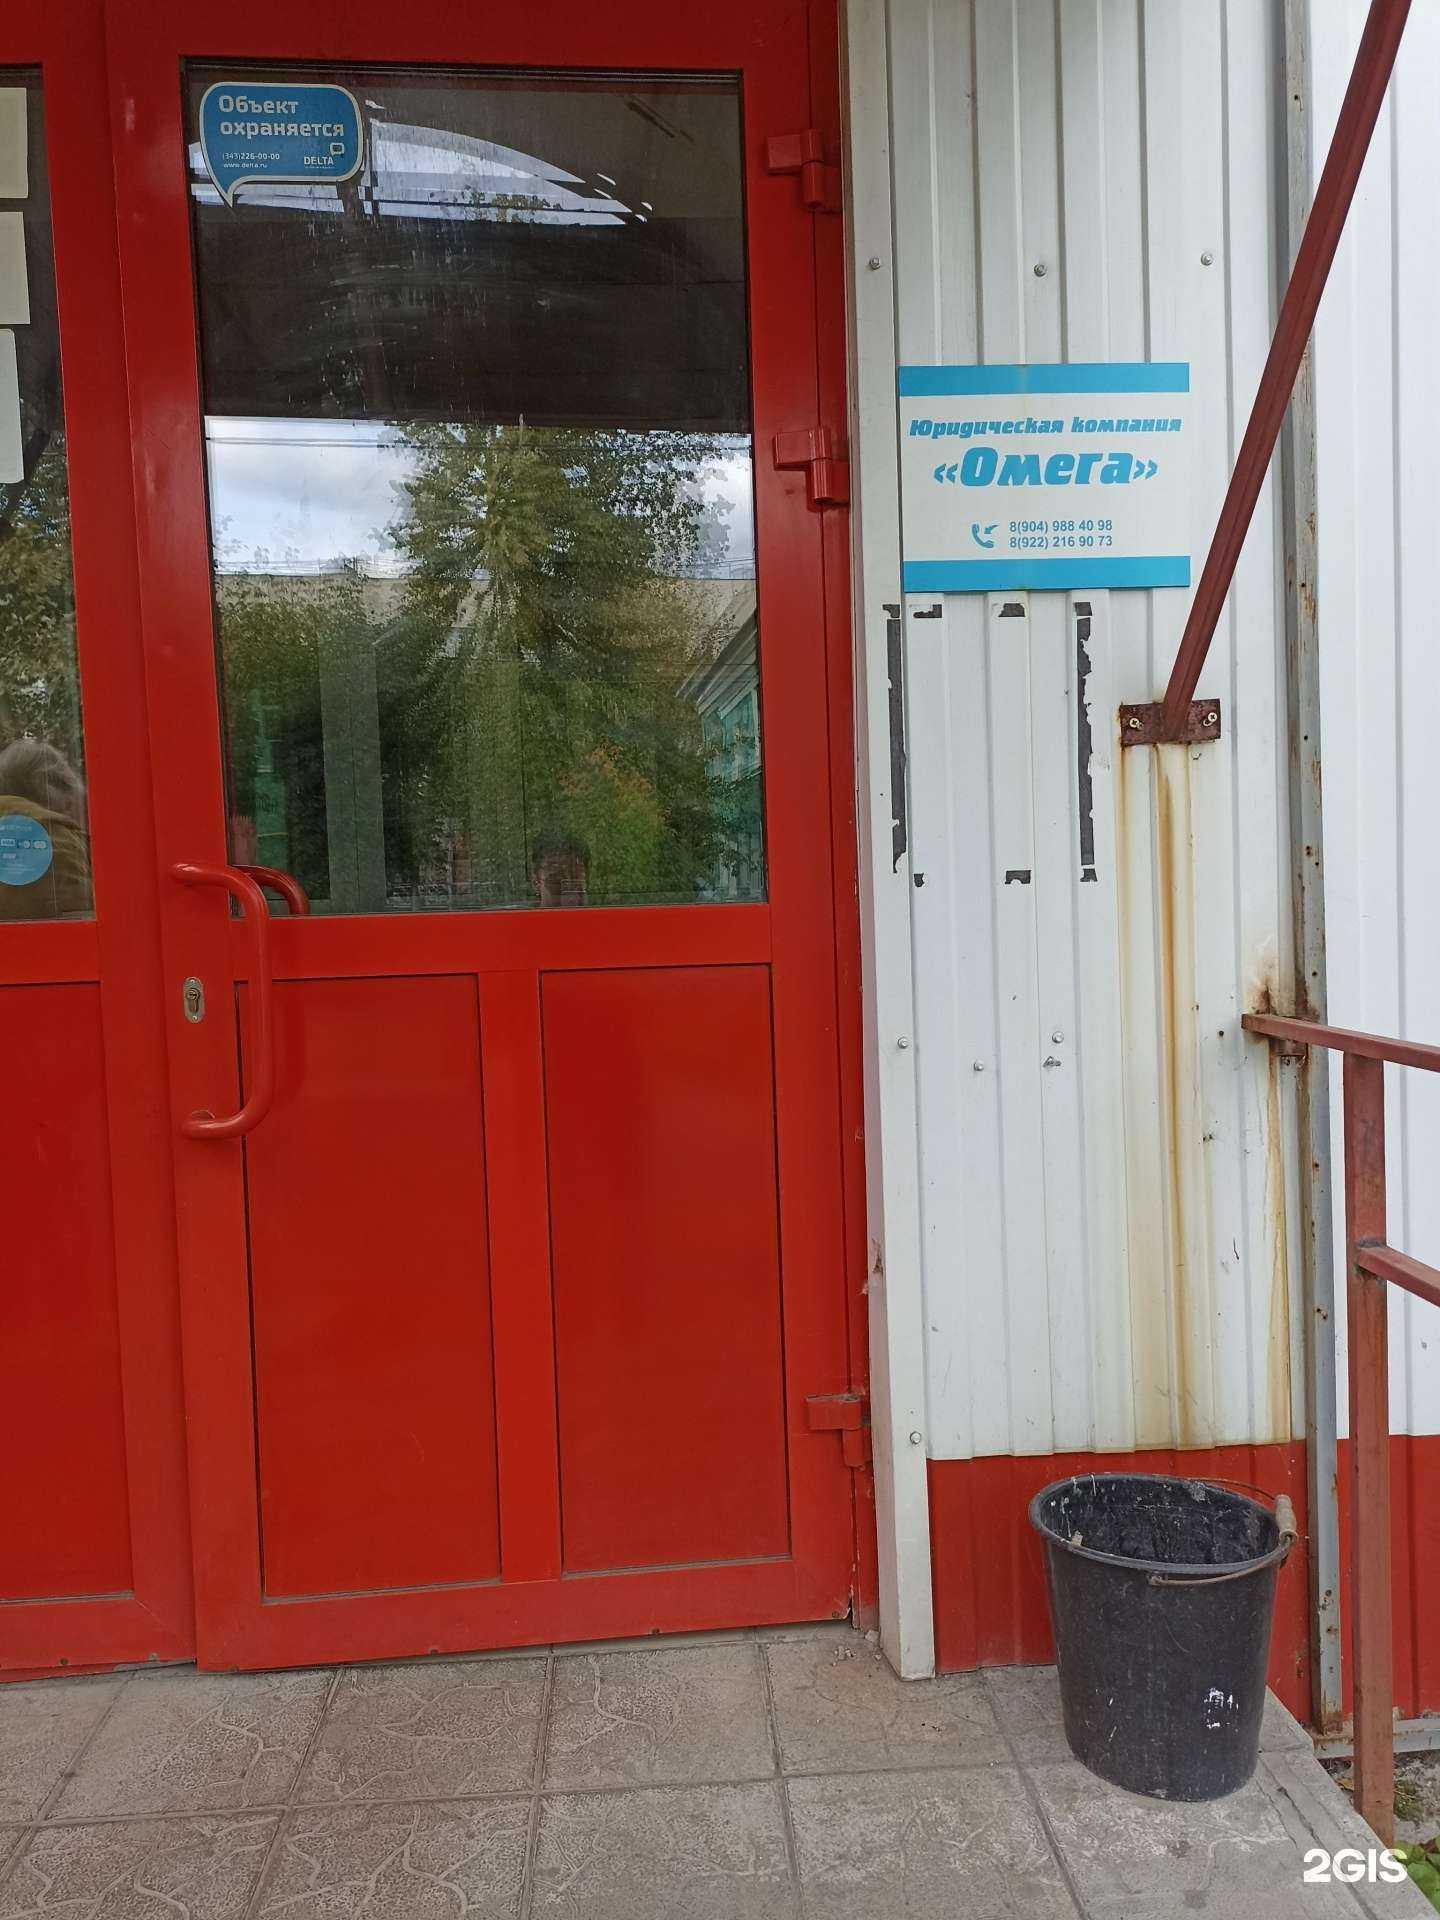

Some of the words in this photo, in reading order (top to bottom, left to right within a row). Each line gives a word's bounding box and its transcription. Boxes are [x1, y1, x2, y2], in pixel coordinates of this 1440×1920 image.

[218, 95, 299, 115] Объект
[219, 121, 345, 140] охраняется
[303, 156, 335, 165] DELTA
[909, 417, 1065, 440] Юридическая
[1070, 416, 1182, 433] компания
[1009, 520, 1049, 535] 8(904)
[1052, 520, 1075, 532] 988
[1078, 519, 1094, 531] 40
[1097, 519, 1113, 531] 98
[1009, 536, 1049, 550] 8(922)
[1052, 536, 1075, 547] 216
[1078, 535, 1094, 547] 90
[1097, 535, 1113, 546] 73
